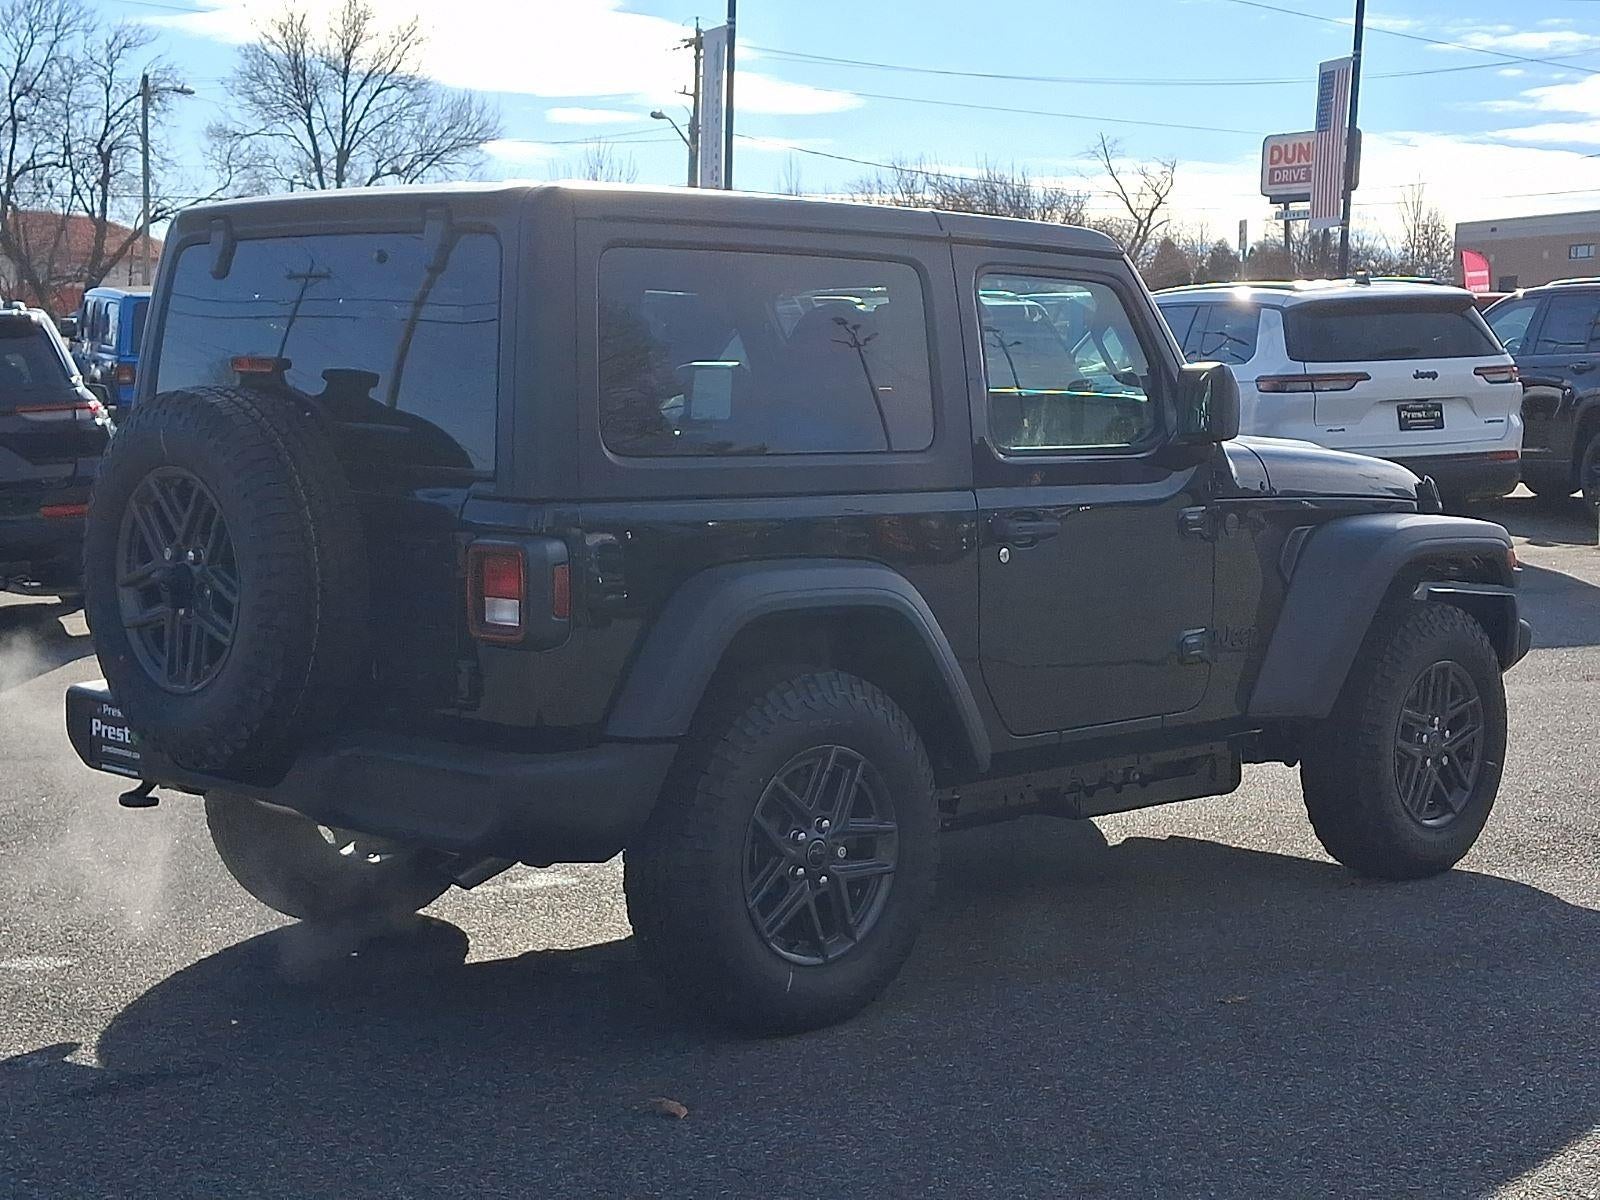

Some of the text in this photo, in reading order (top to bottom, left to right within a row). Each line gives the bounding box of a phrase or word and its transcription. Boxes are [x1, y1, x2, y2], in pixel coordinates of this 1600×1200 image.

[1269, 141, 1315, 165] DUN
[1274, 168, 1307, 182] DRIVE
[1413, 369, 1439, 380] Jeep
